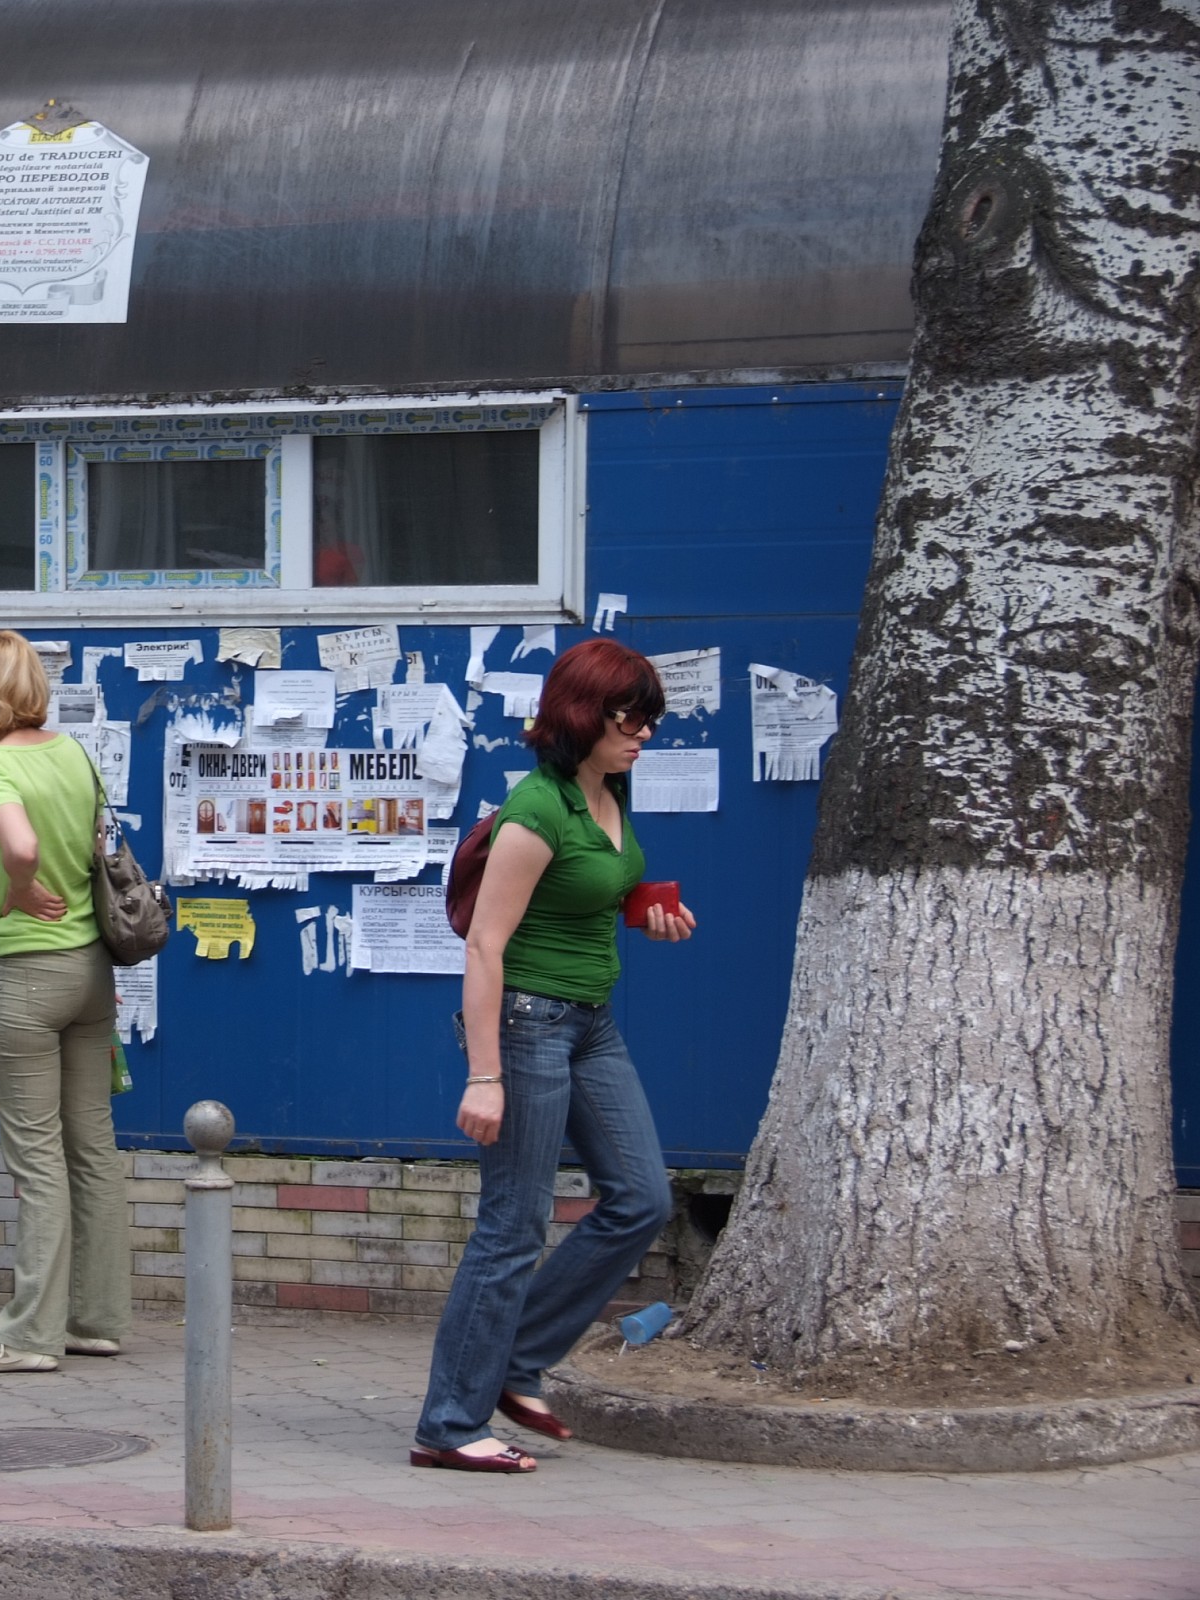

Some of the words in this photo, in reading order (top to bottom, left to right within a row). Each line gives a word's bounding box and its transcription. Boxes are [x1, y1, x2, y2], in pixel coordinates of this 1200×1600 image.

[19, 153, 34, 161] de
[39, 151, 123, 161] TRADUCERI
[0, 164, 51, 174] legalizare
[54, 163, 103, 171] notarială
[20, 172, 110, 183] ПЕРЕВОДОВ
[57, 184, 106, 194] заверкой
[75, 207, 84, 215] al
[88, 206, 103, 215] RM
[39, 456, 53, 466] 60
[39, 534, 53, 545] 60
[335, 628, 382, 643] КУРСЫ
[136, 642, 190, 652] Электрик!
[50, 688, 92, 696] ravelia.md
[199, 753, 267, 781] ОКНА-ДВЕРИ
[350, 753, 424, 780] МЕБЕЛЬ
[360, 886, 448, 897] КУРСЫ-CURSU
